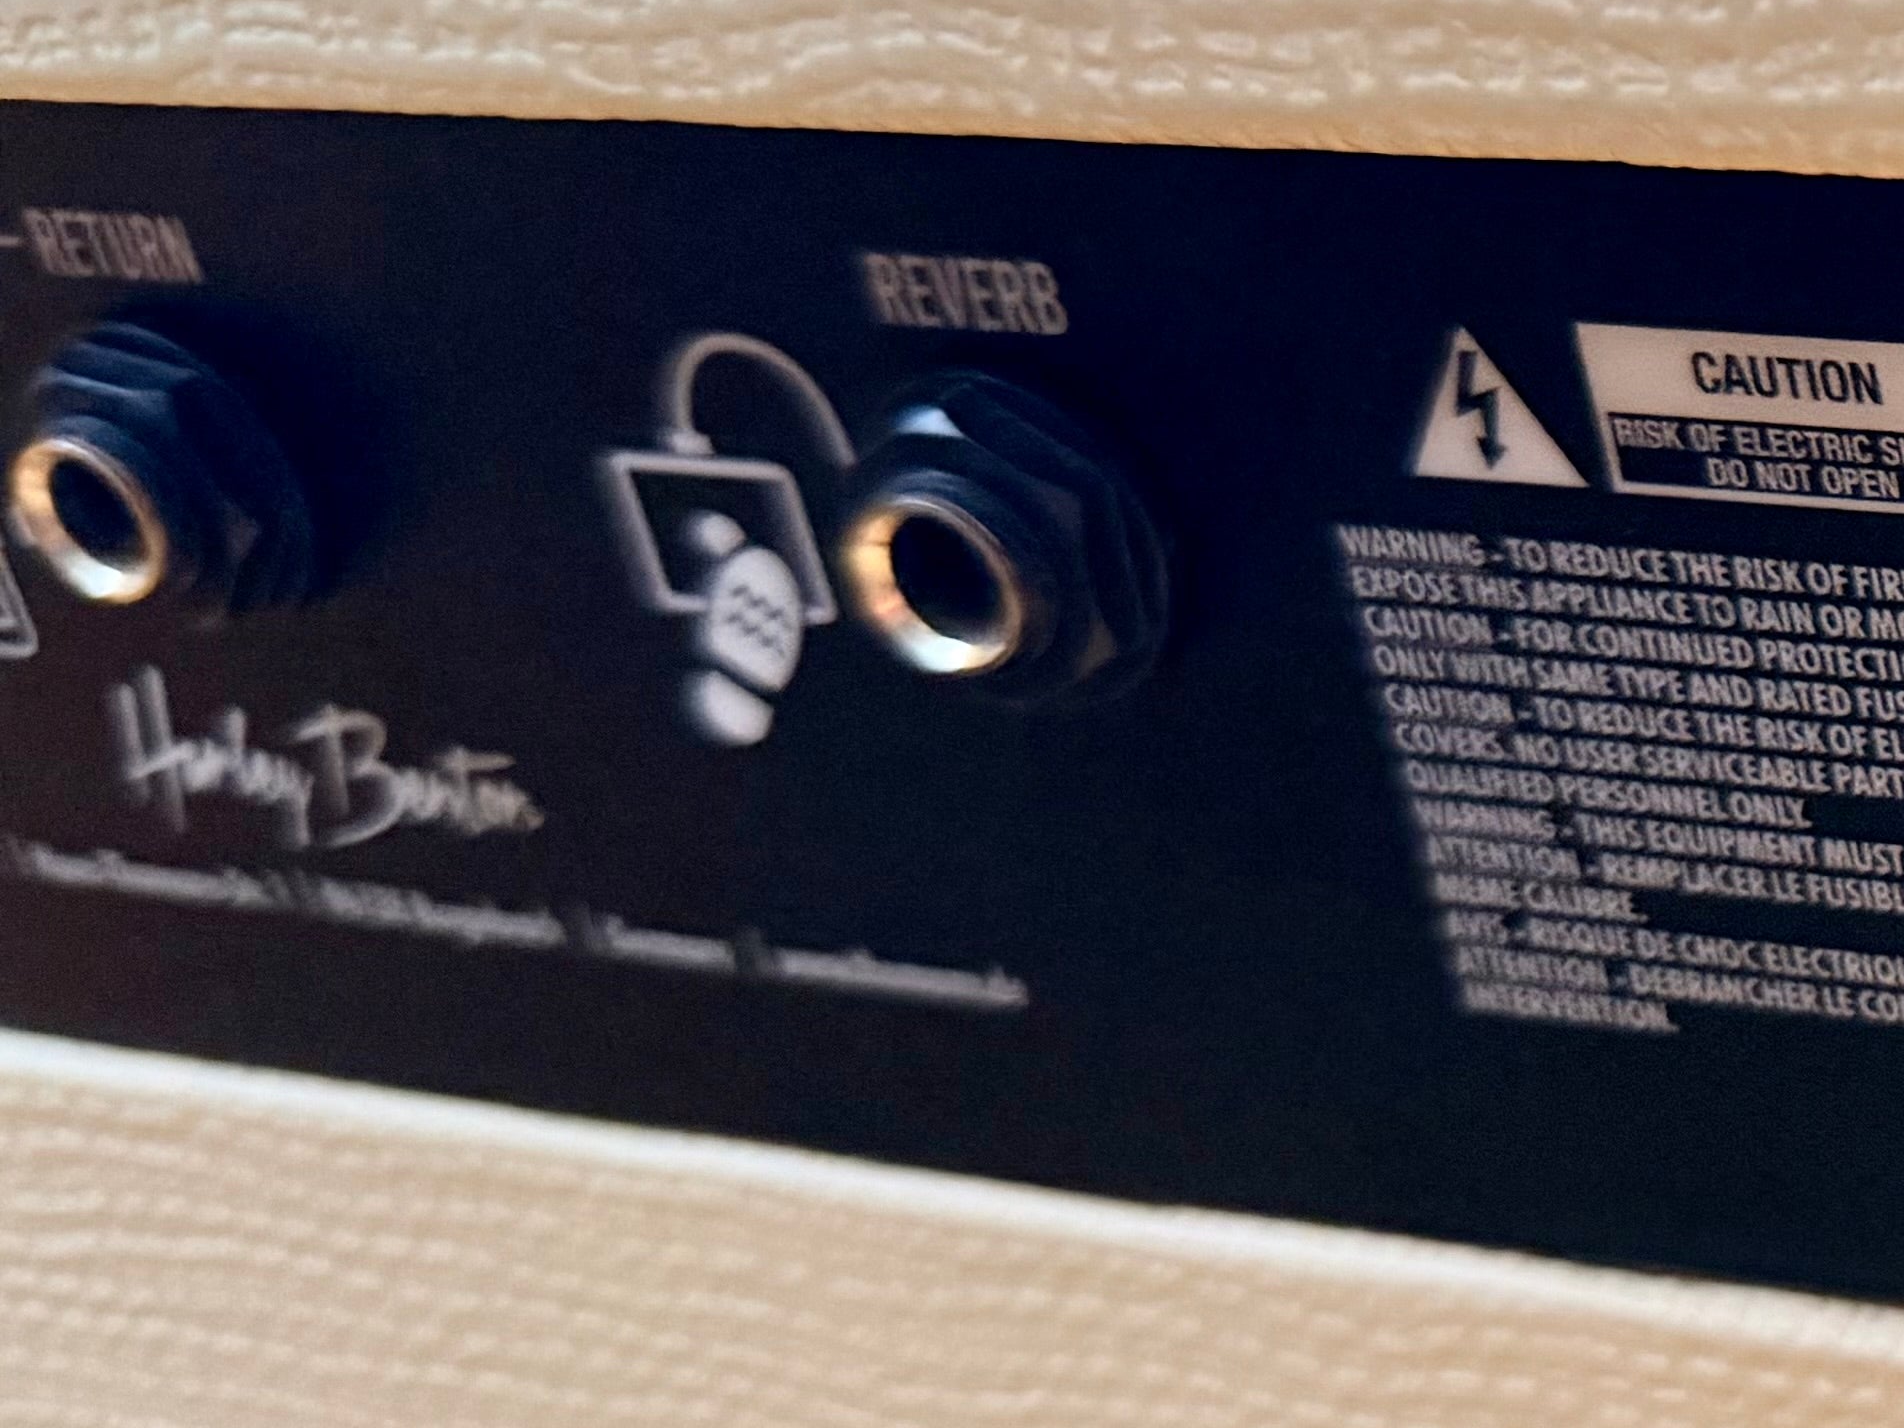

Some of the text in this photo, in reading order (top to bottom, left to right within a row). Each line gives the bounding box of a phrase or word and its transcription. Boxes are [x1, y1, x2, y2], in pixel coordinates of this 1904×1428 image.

[24, 207, 202, 282] RETURN
[861, 252, 1069, 335] REVERB
[1690, 351, 1883, 405] CAUTION
[1614, 417, 1686, 451] RISK
[1689, 419, 1726, 454] OF
[1734, 427, 1875, 465] ELECTRIC
[1707, 457, 1900, 499] DO NOT OPEN
[1338, 526, 1484, 566] WARNING
[1503, 537, 1547, 572] TO
[1549, 541, 1669, 581] REDUCE
[1668, 550, 1731, 586] THE
[1732, 555, 1804, 591] RISK
[1805, 562, 1848, 595] OF
[1349, 565, 1458, 604] EXPOSE
[1530, 580, 1692, 623] APPLIANCE
[1691, 592, 1736, 627] TO
[1739, 597, 1815, 633] RAIN
[1818, 604, 1866, 638] OR
[1362, 605, 1493, 644] CAUTION
[1513, 617, 1575, 652] FOR
[1576, 624, 1754, 667] CONTINUED
[1372, 644, 1444, 678] ONLY
[1531, 658, 1614, 694] SAME
[1613, 665, 1685, 700] TYPE
[1688, 672, 1753, 706] AND
[1755, 678, 1851, 715] RATED
[1383, 683, 1514, 723] CAUTION
[1532, 696, 1575, 729] TO
[1574, 700, 1694, 740] REDUCE
[1693, 711, 1754, 746] THE
[1754, 716, 1827, 752] RISK
[1826, 723, 1867, 756] OF
[1512, 734, 1561, 765] NO
[1562, 738, 1640, 772] USER
[1639, 745, 1831, 792] SERVICEABLE
[1575, 813, 1643, 848] THIS
[1645, 820, 1815, 865] EQUIPMENT
[1821, 838, 1903, 875] MUST
[1770, 871, 1805, 901] LE
[1822, 986, 1855, 1016] LE
